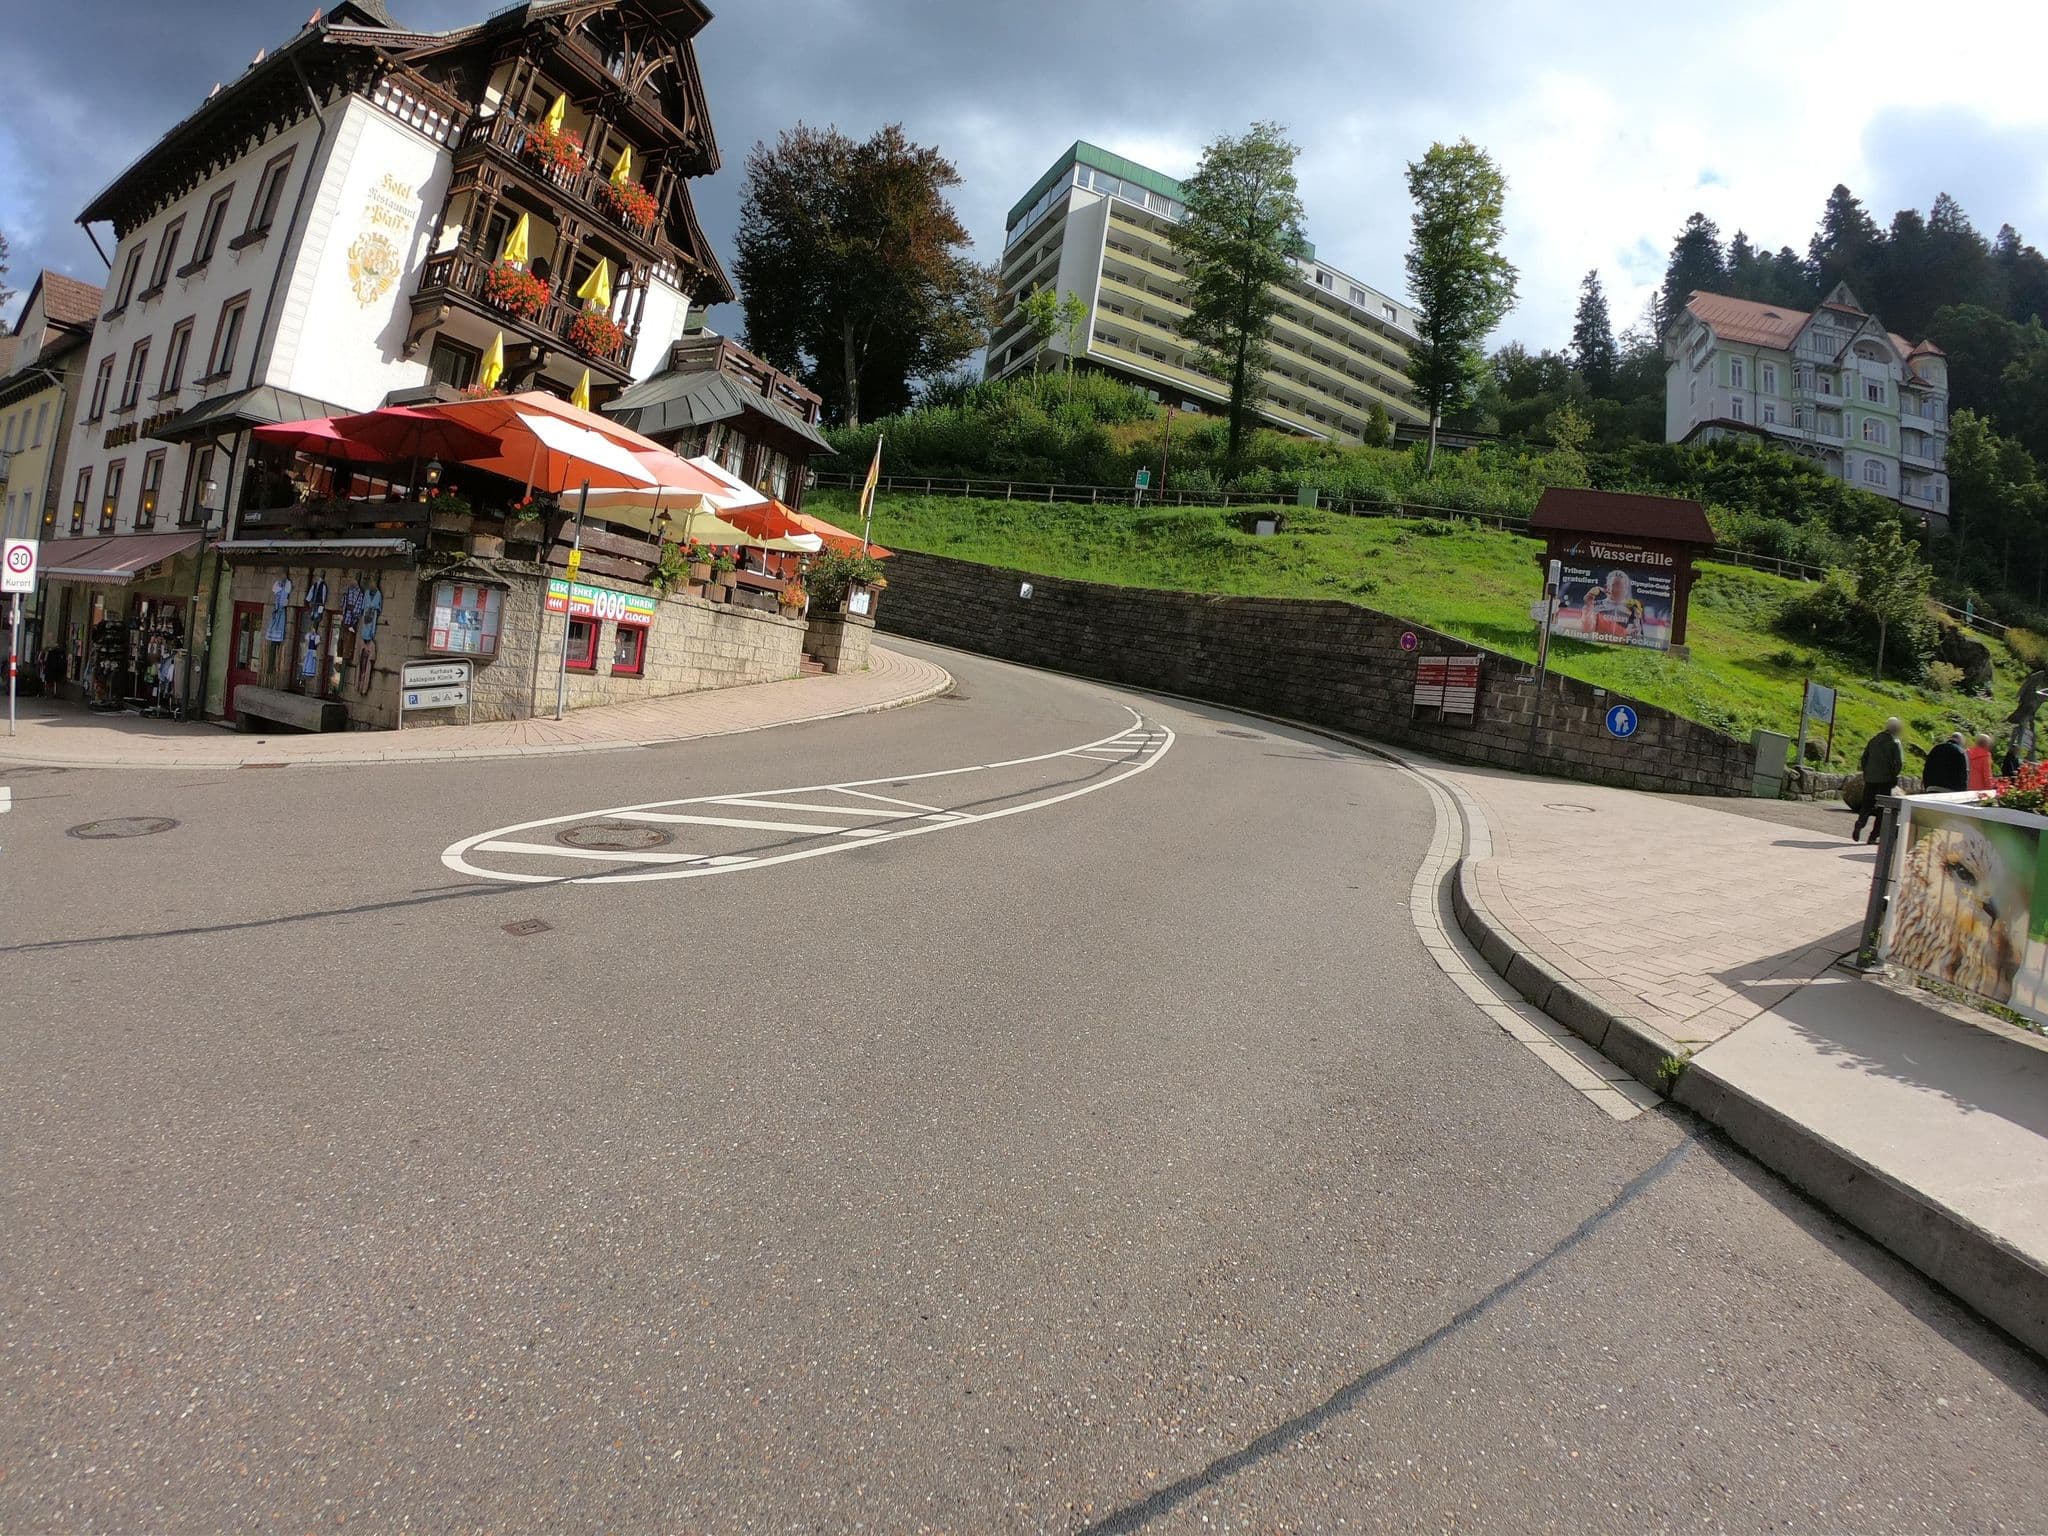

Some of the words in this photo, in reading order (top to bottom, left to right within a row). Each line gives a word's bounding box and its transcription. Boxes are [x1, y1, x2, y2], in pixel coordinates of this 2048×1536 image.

[382, 172, 411, 199] Hotel
[368, 187, 416, 220] Restaurant
[12, 552, 28, 566] 30
[1589, 545, 1673, 566] Wasserfälle
[1563, 566, 1591, 576] Triberg
[5, 578, 31, 587] Kurort
[1562, 575, 1599, 585] gratuliert
[550, 583, 592, 598] GESCENKE
[592, 591, 626, 619] 1000
[629, 597, 653, 609] UHREN
[625, 613, 650, 623] CLOCKS
[1563, 628, 1589, 640] Aline
[1591, 631, 1662, 648] Rotter-Focken
